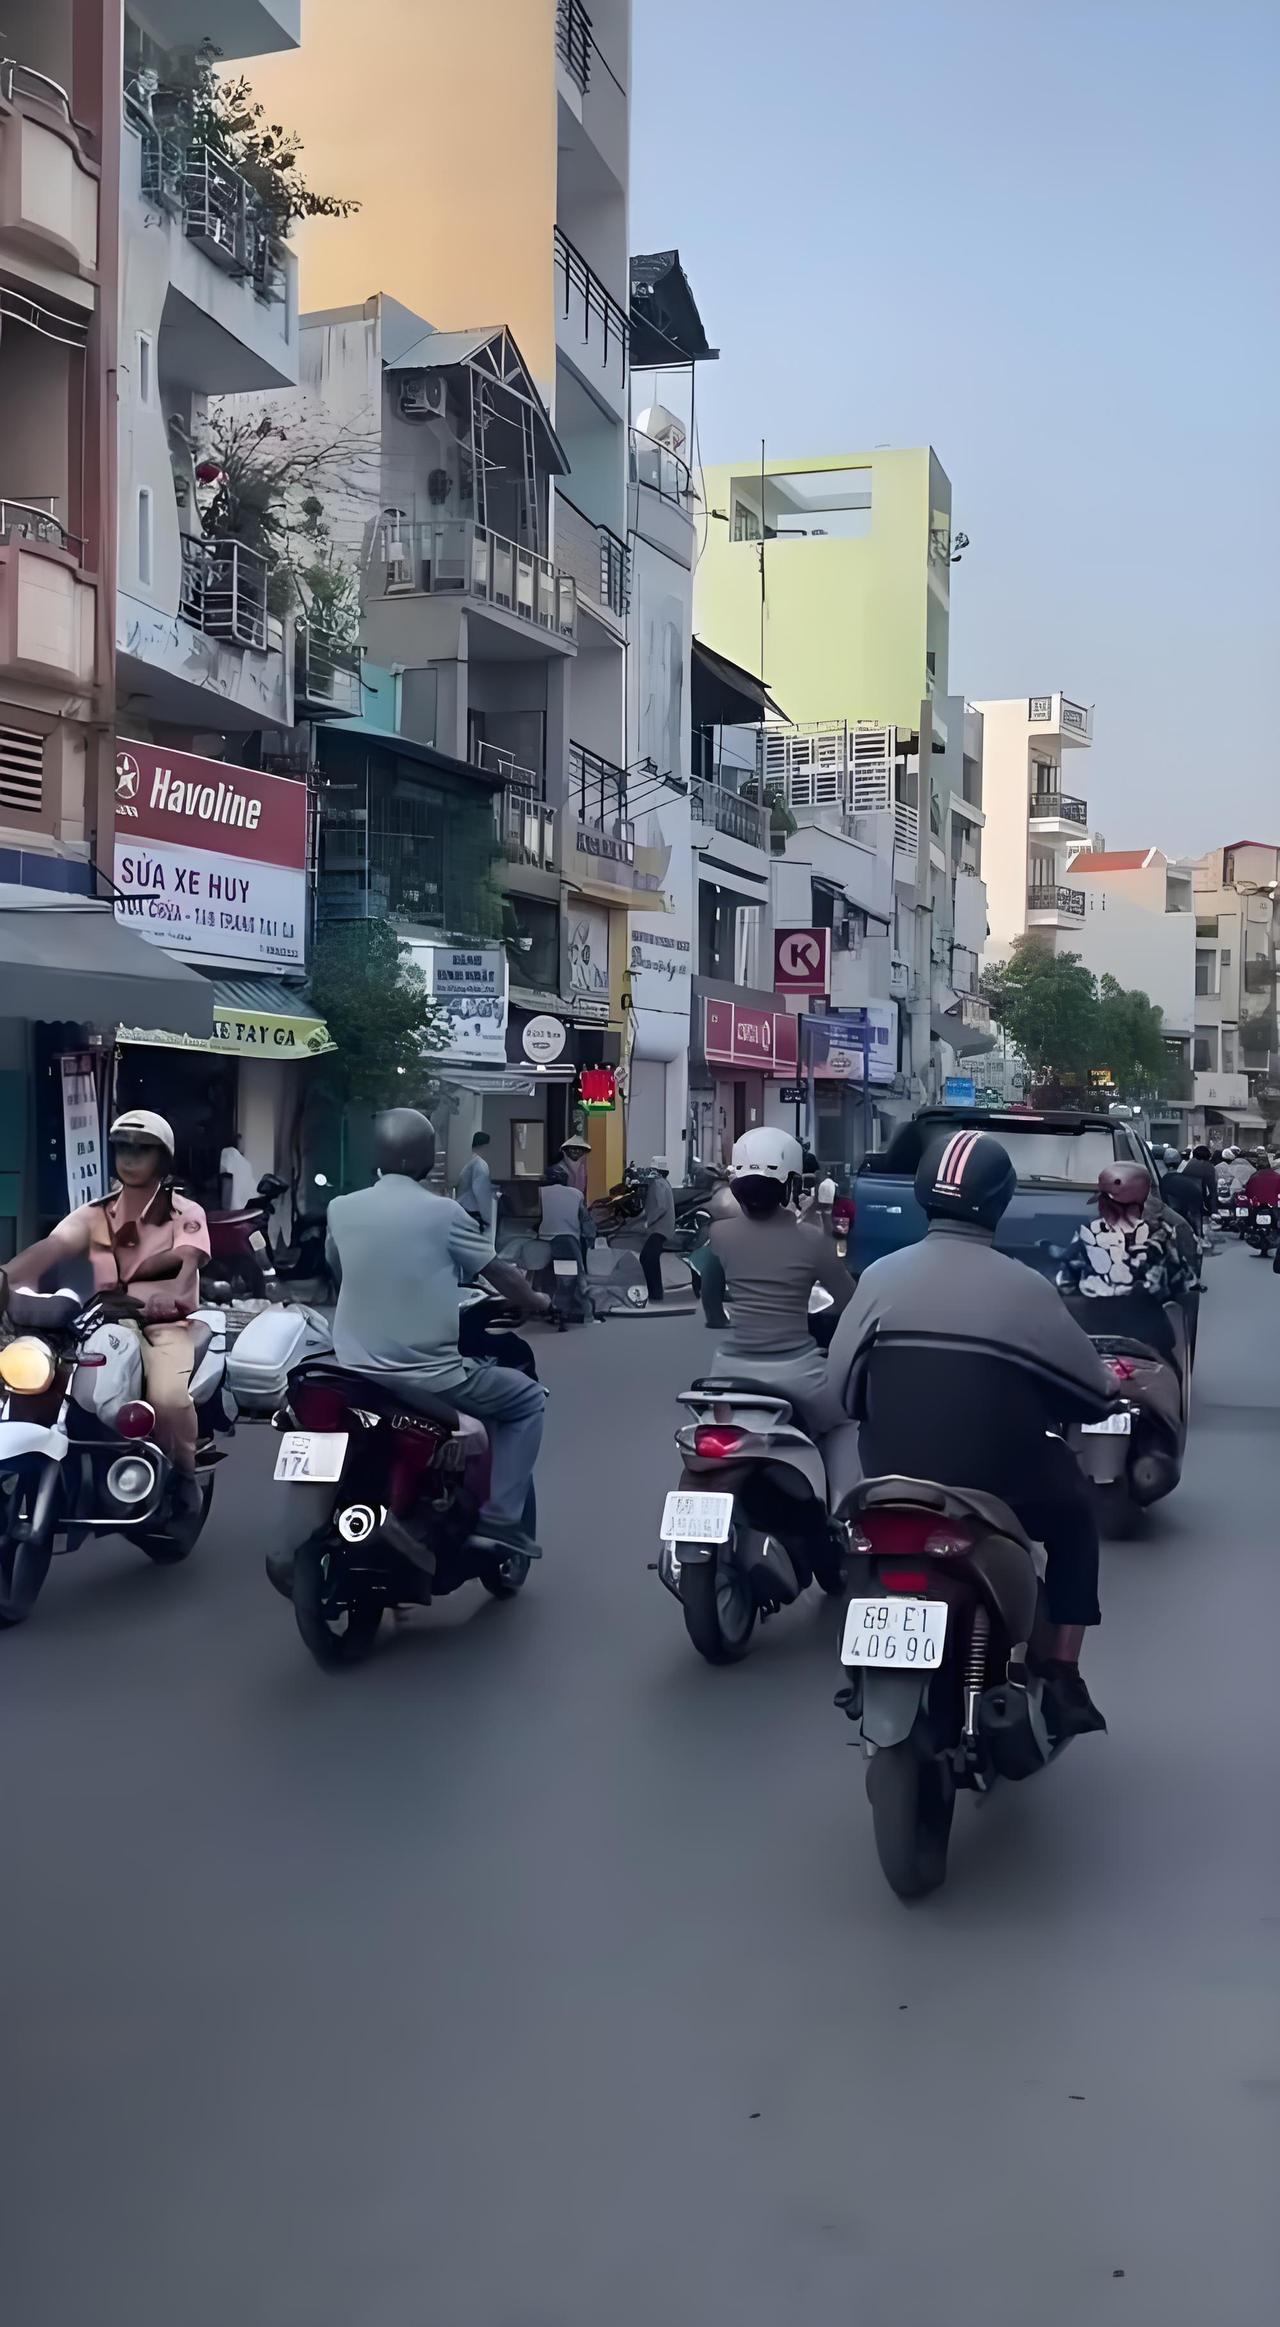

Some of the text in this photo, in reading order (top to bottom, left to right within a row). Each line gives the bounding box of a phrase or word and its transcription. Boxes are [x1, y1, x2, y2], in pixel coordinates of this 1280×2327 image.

[150, 767, 262, 830] Havoline
[121, 852, 250, 904] SỬA XE HUY
[273, 1028, 295, 1046] GA
